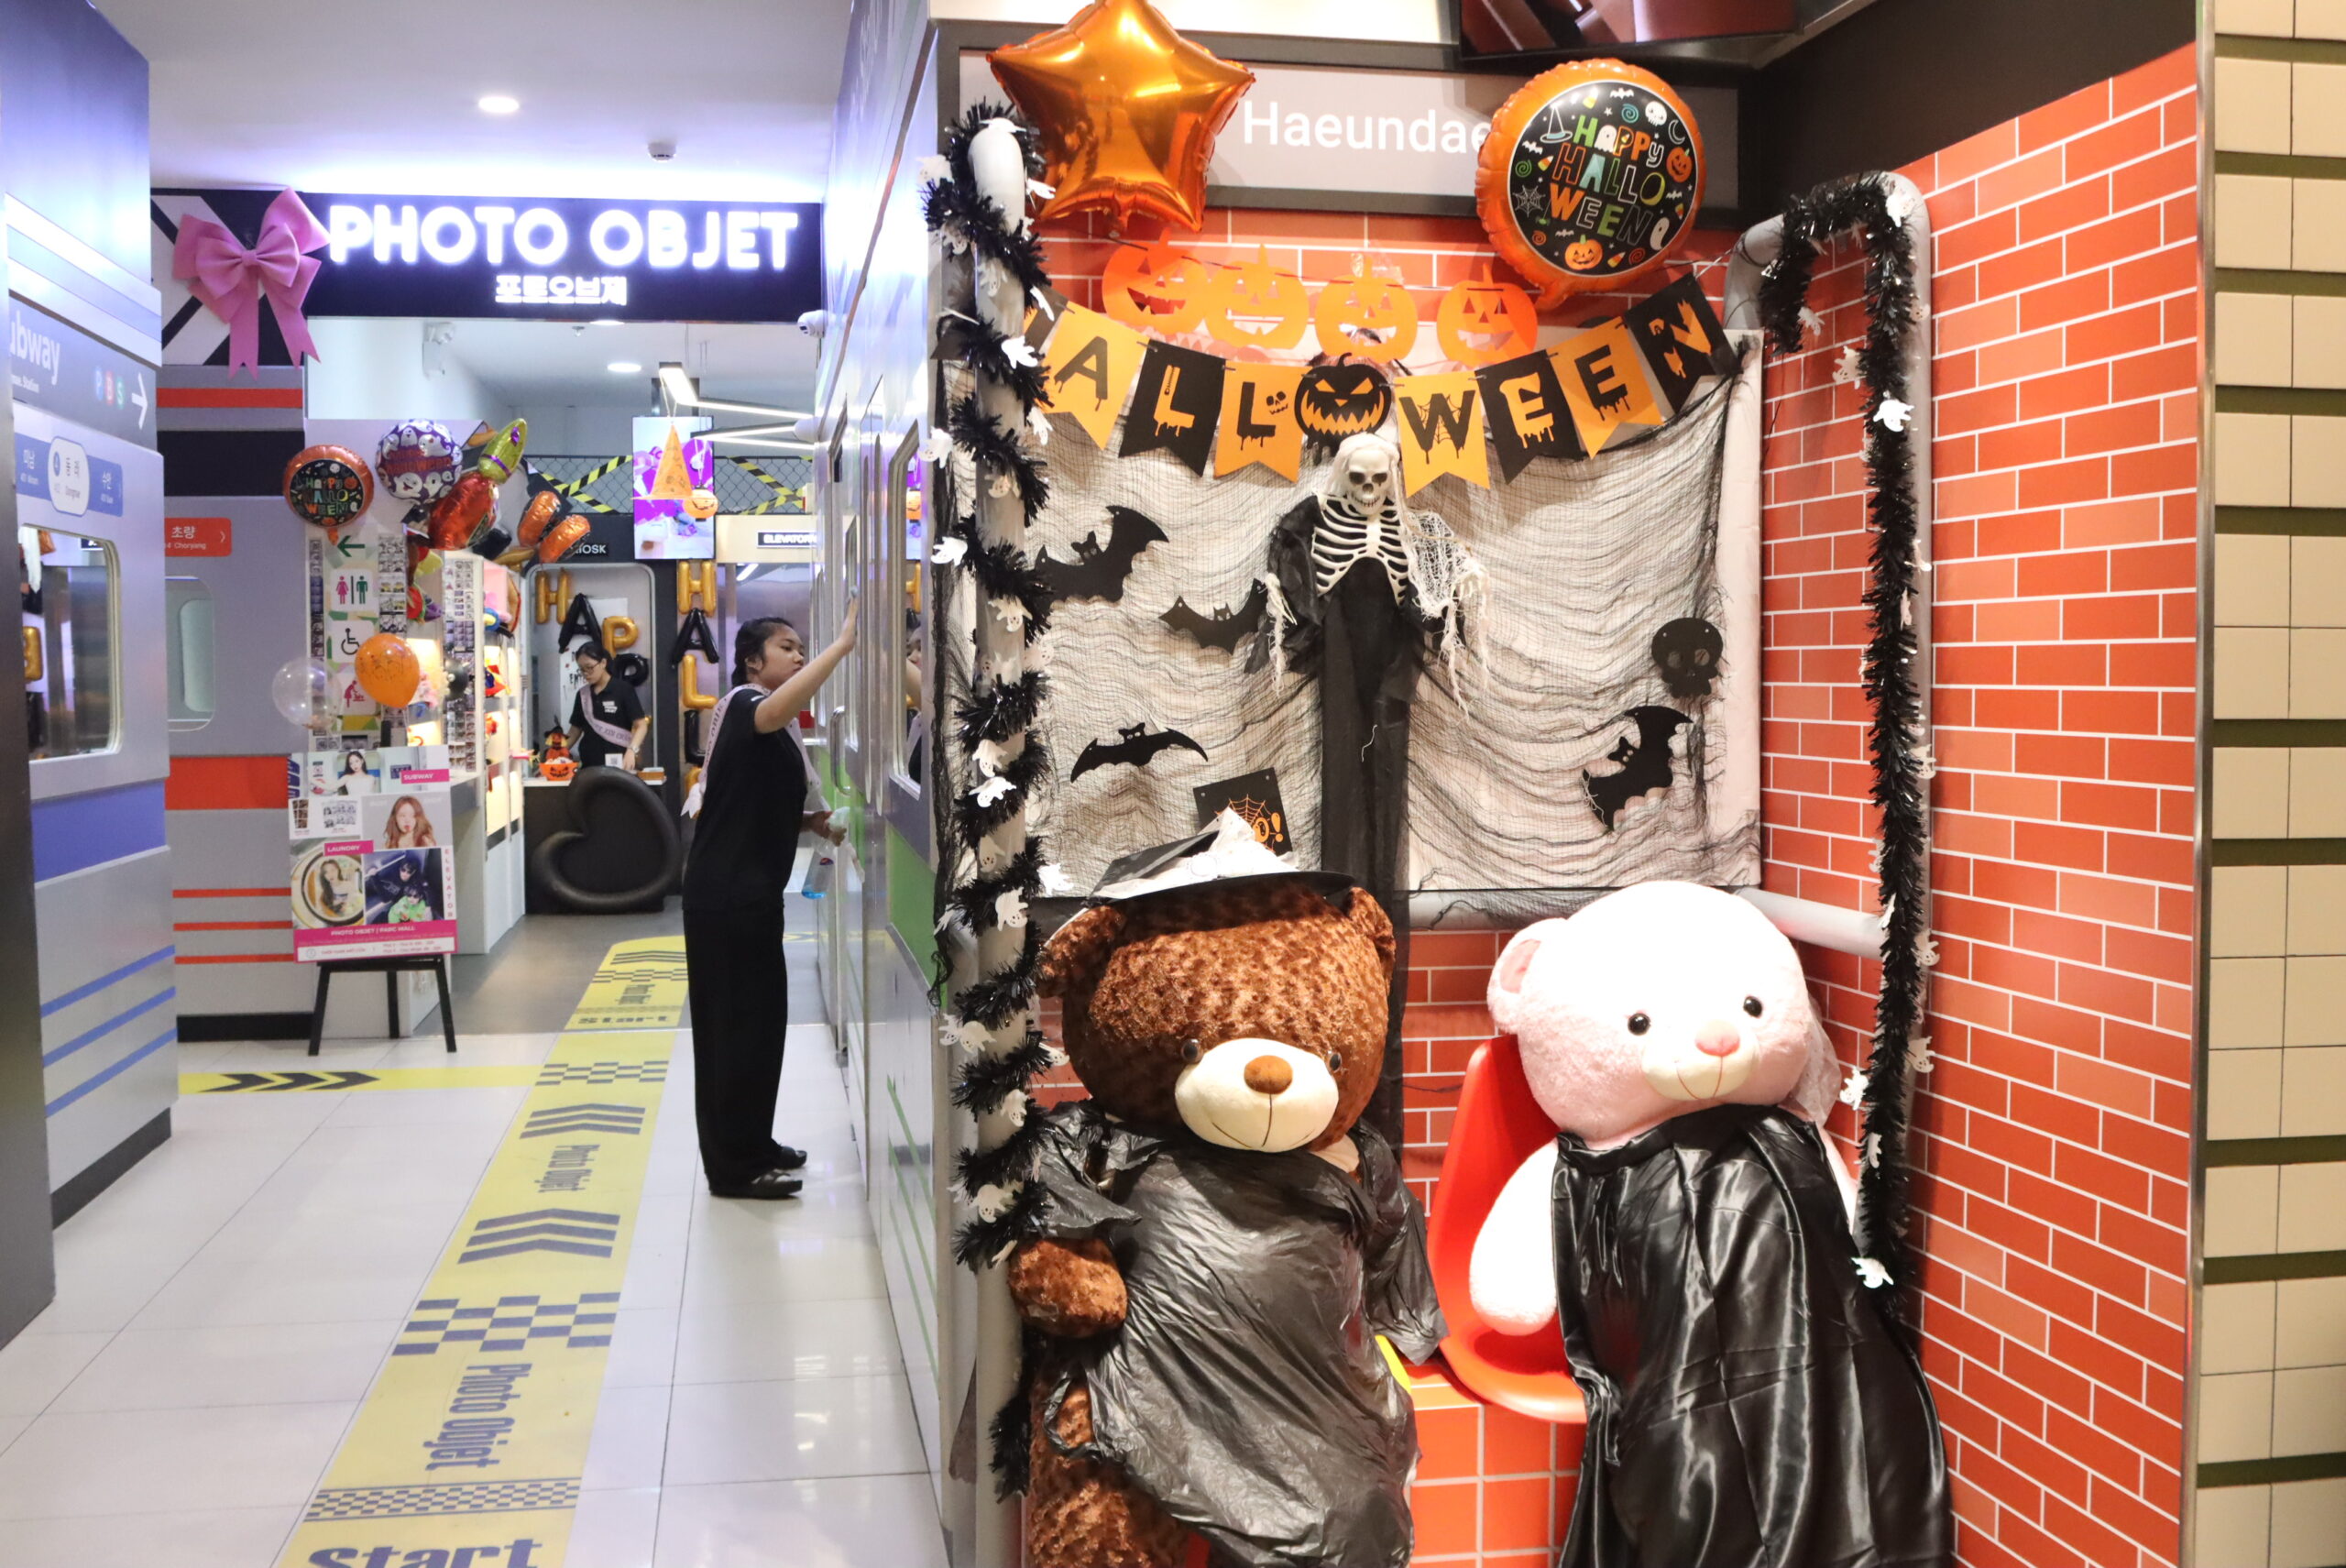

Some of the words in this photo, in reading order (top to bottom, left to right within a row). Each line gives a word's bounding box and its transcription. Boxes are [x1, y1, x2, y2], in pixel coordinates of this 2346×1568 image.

[1244, 100, 1493, 154] Haeundae
[1573, 115, 1664, 169] HAPPY
[1551, 142, 1666, 206] HALLO
[329, 204, 568, 267] PHOTO
[589, 208, 799, 270] OBJET
[1550, 182, 1653, 246] WEEN
[10, 310, 60, 386] ubway
[1024, 299, 1713, 466] ALLOWEEN
[170, 525, 196, 540] 초량
[576, 544, 607, 554] IOSK
[327, 844, 360, 853] LAUNDRY
[1252, 812, 1283, 843] O!
[444, 849, 454, 917] ELEVATOR
